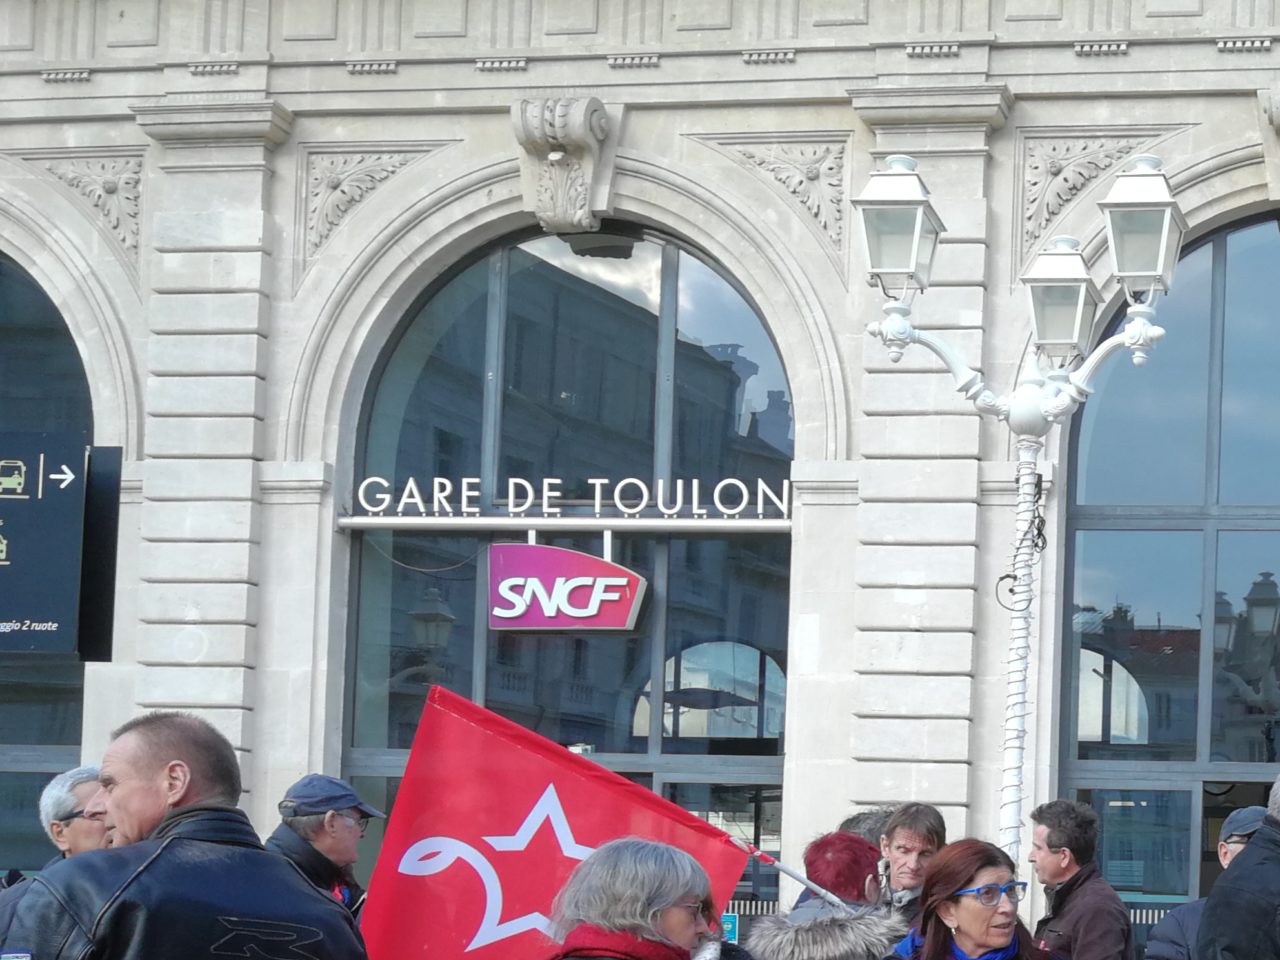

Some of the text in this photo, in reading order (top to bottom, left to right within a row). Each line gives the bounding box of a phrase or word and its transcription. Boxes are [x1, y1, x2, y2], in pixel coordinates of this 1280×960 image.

[357, 476, 790, 516] GARE DE TOULON
[492, 576, 628, 619] SNCF
[21, 620, 30, 630] 2
[30, 621, 59, 631] ruote
